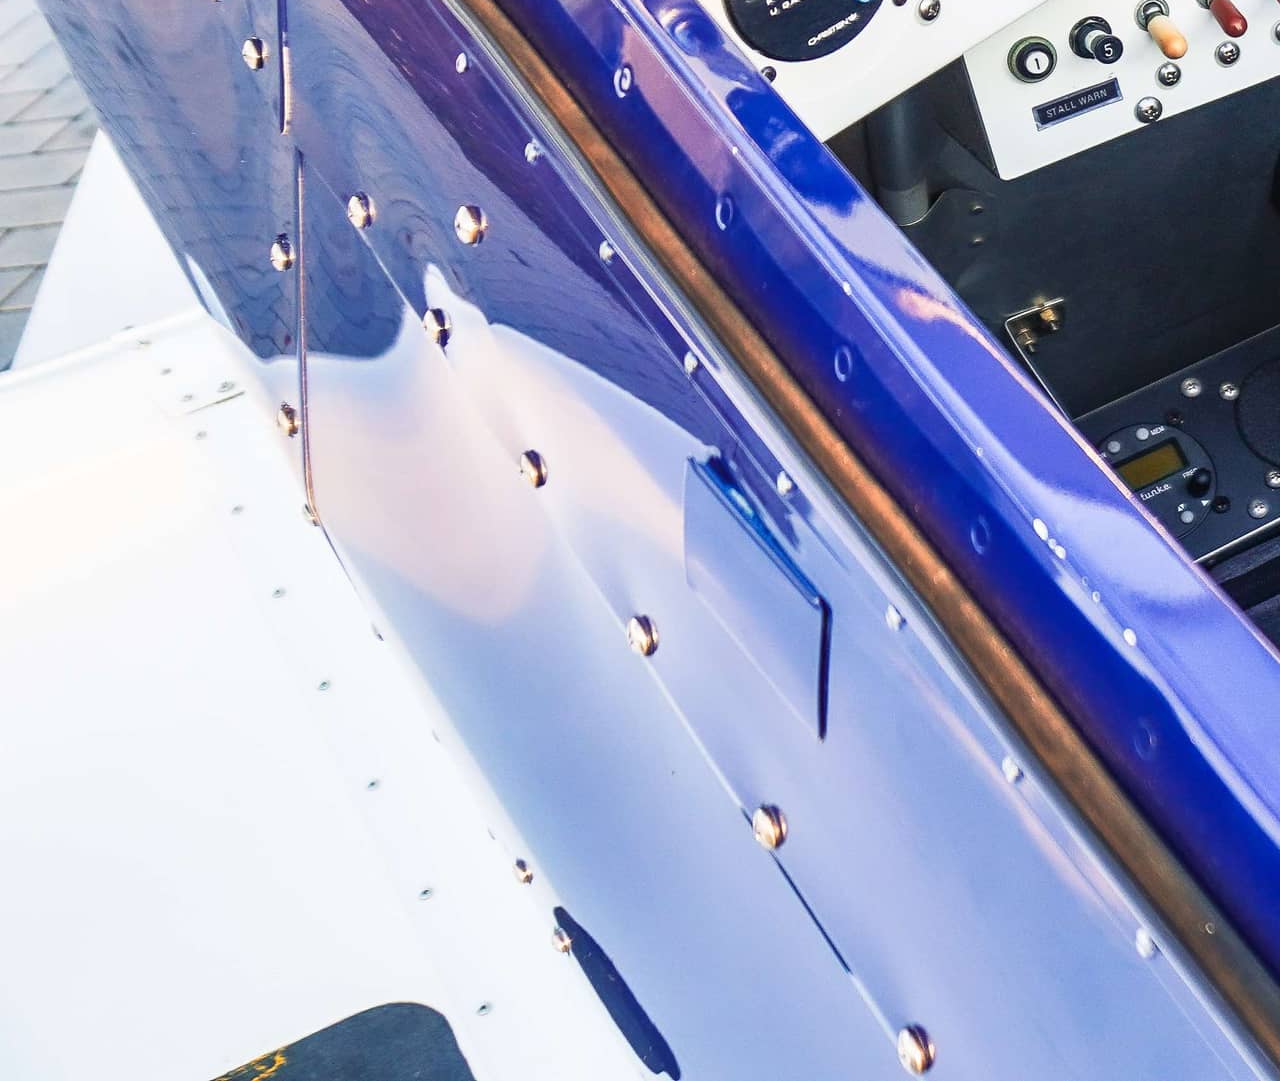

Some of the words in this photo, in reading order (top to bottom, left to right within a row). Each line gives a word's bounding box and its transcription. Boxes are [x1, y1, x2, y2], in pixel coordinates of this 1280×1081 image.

[1104, 43, 1113, 57] 5
[1046, 102, 1077, 118] STALL
[1078, 88, 1108, 106] WARN
